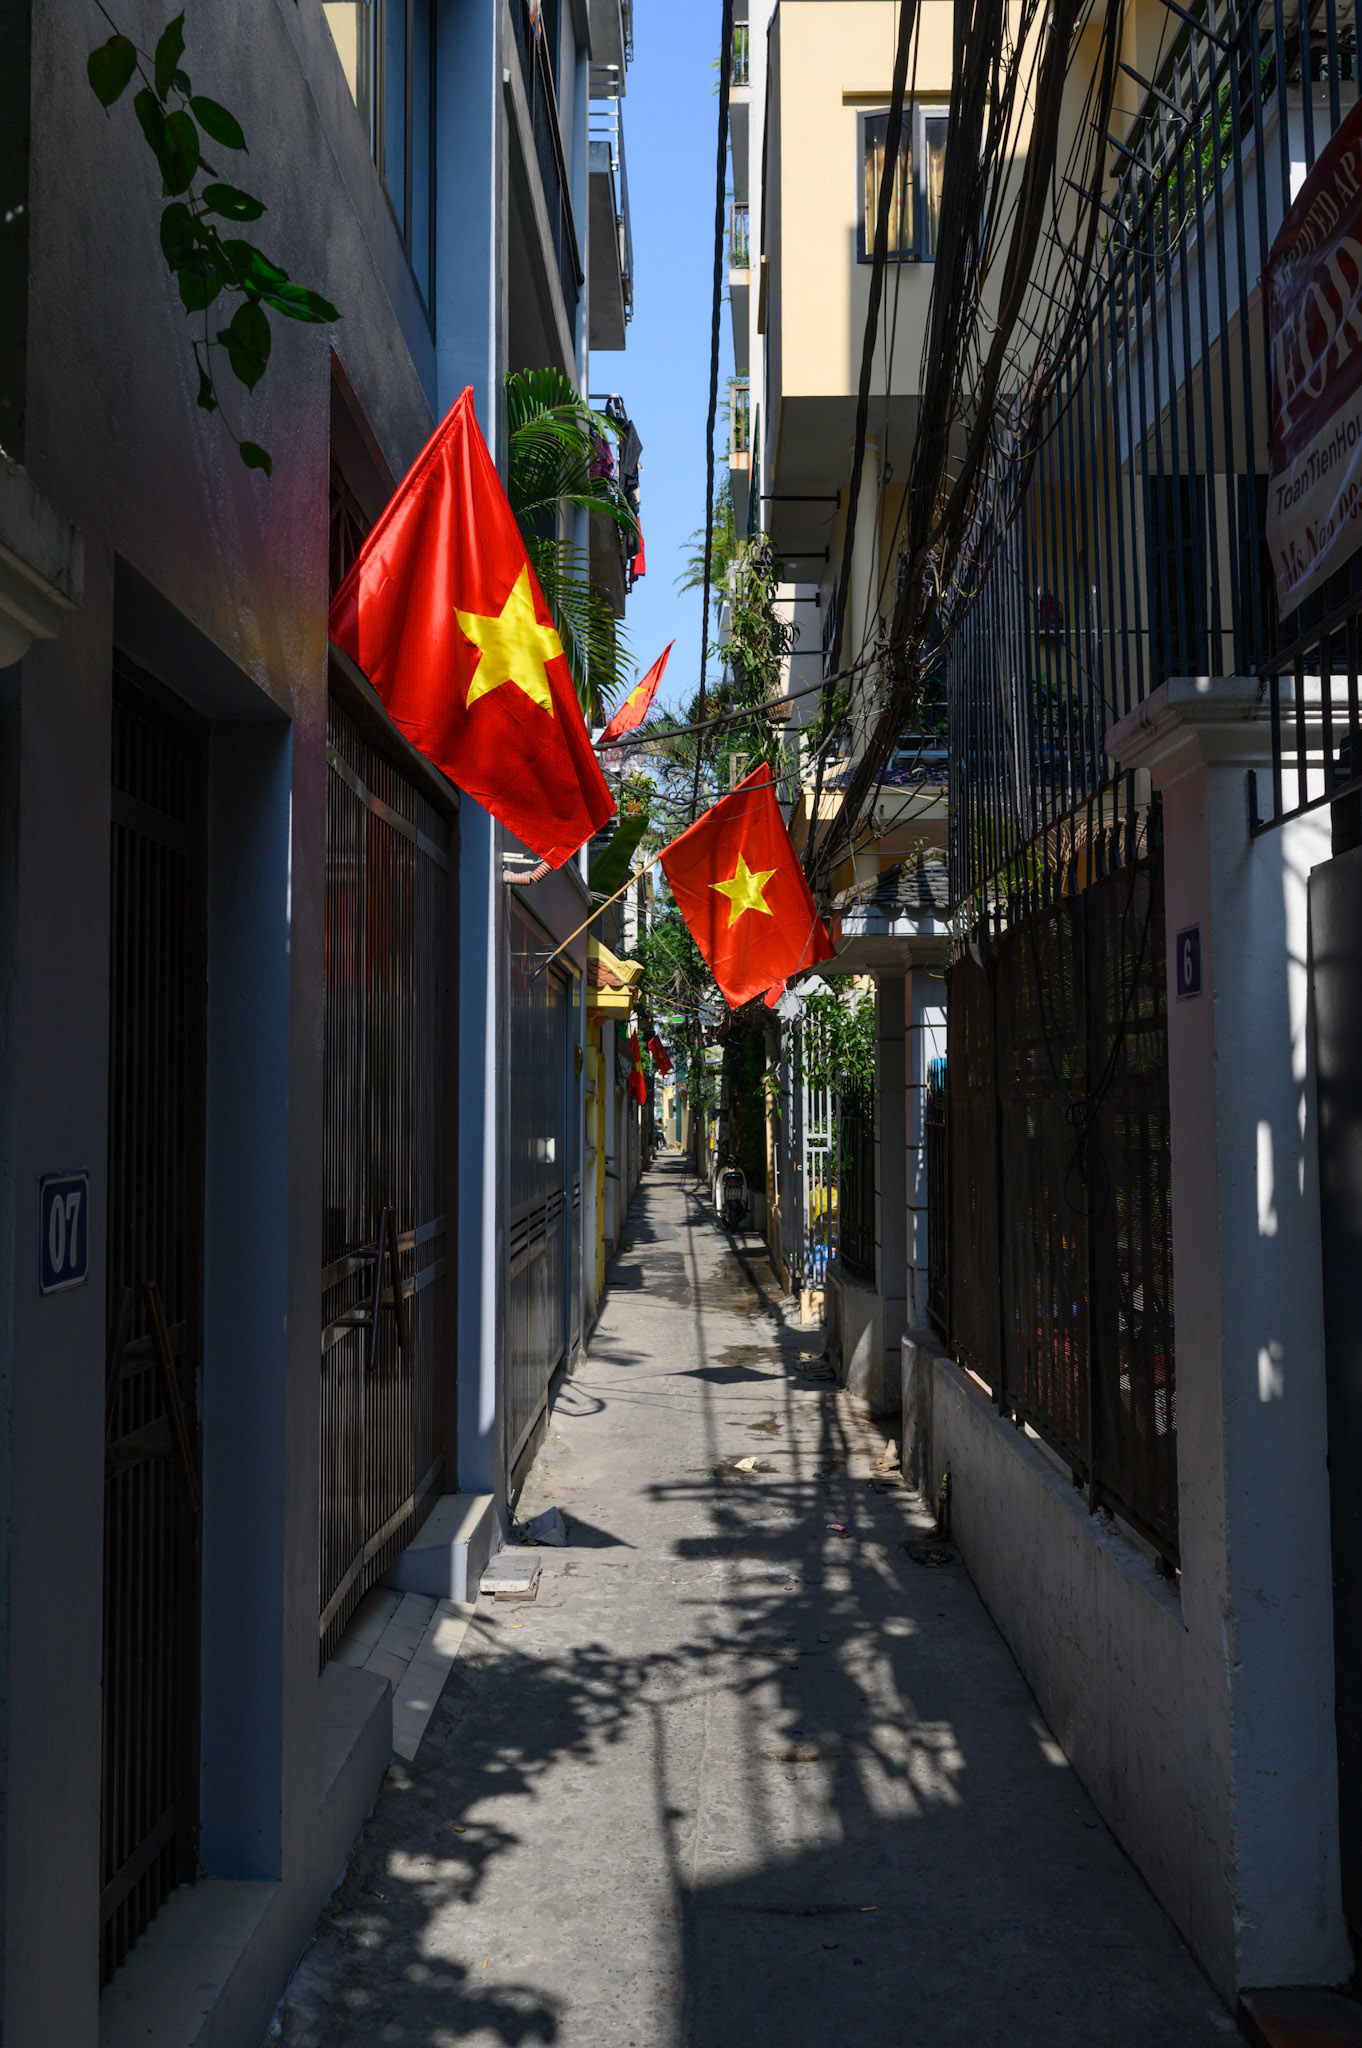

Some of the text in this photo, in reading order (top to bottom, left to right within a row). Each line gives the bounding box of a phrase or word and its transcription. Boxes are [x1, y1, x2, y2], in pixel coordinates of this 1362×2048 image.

[1273, 236, 1362, 440] FOR
[1183, 938, 1193, 986] 6
[48, 1191, 82, 1274] 07
